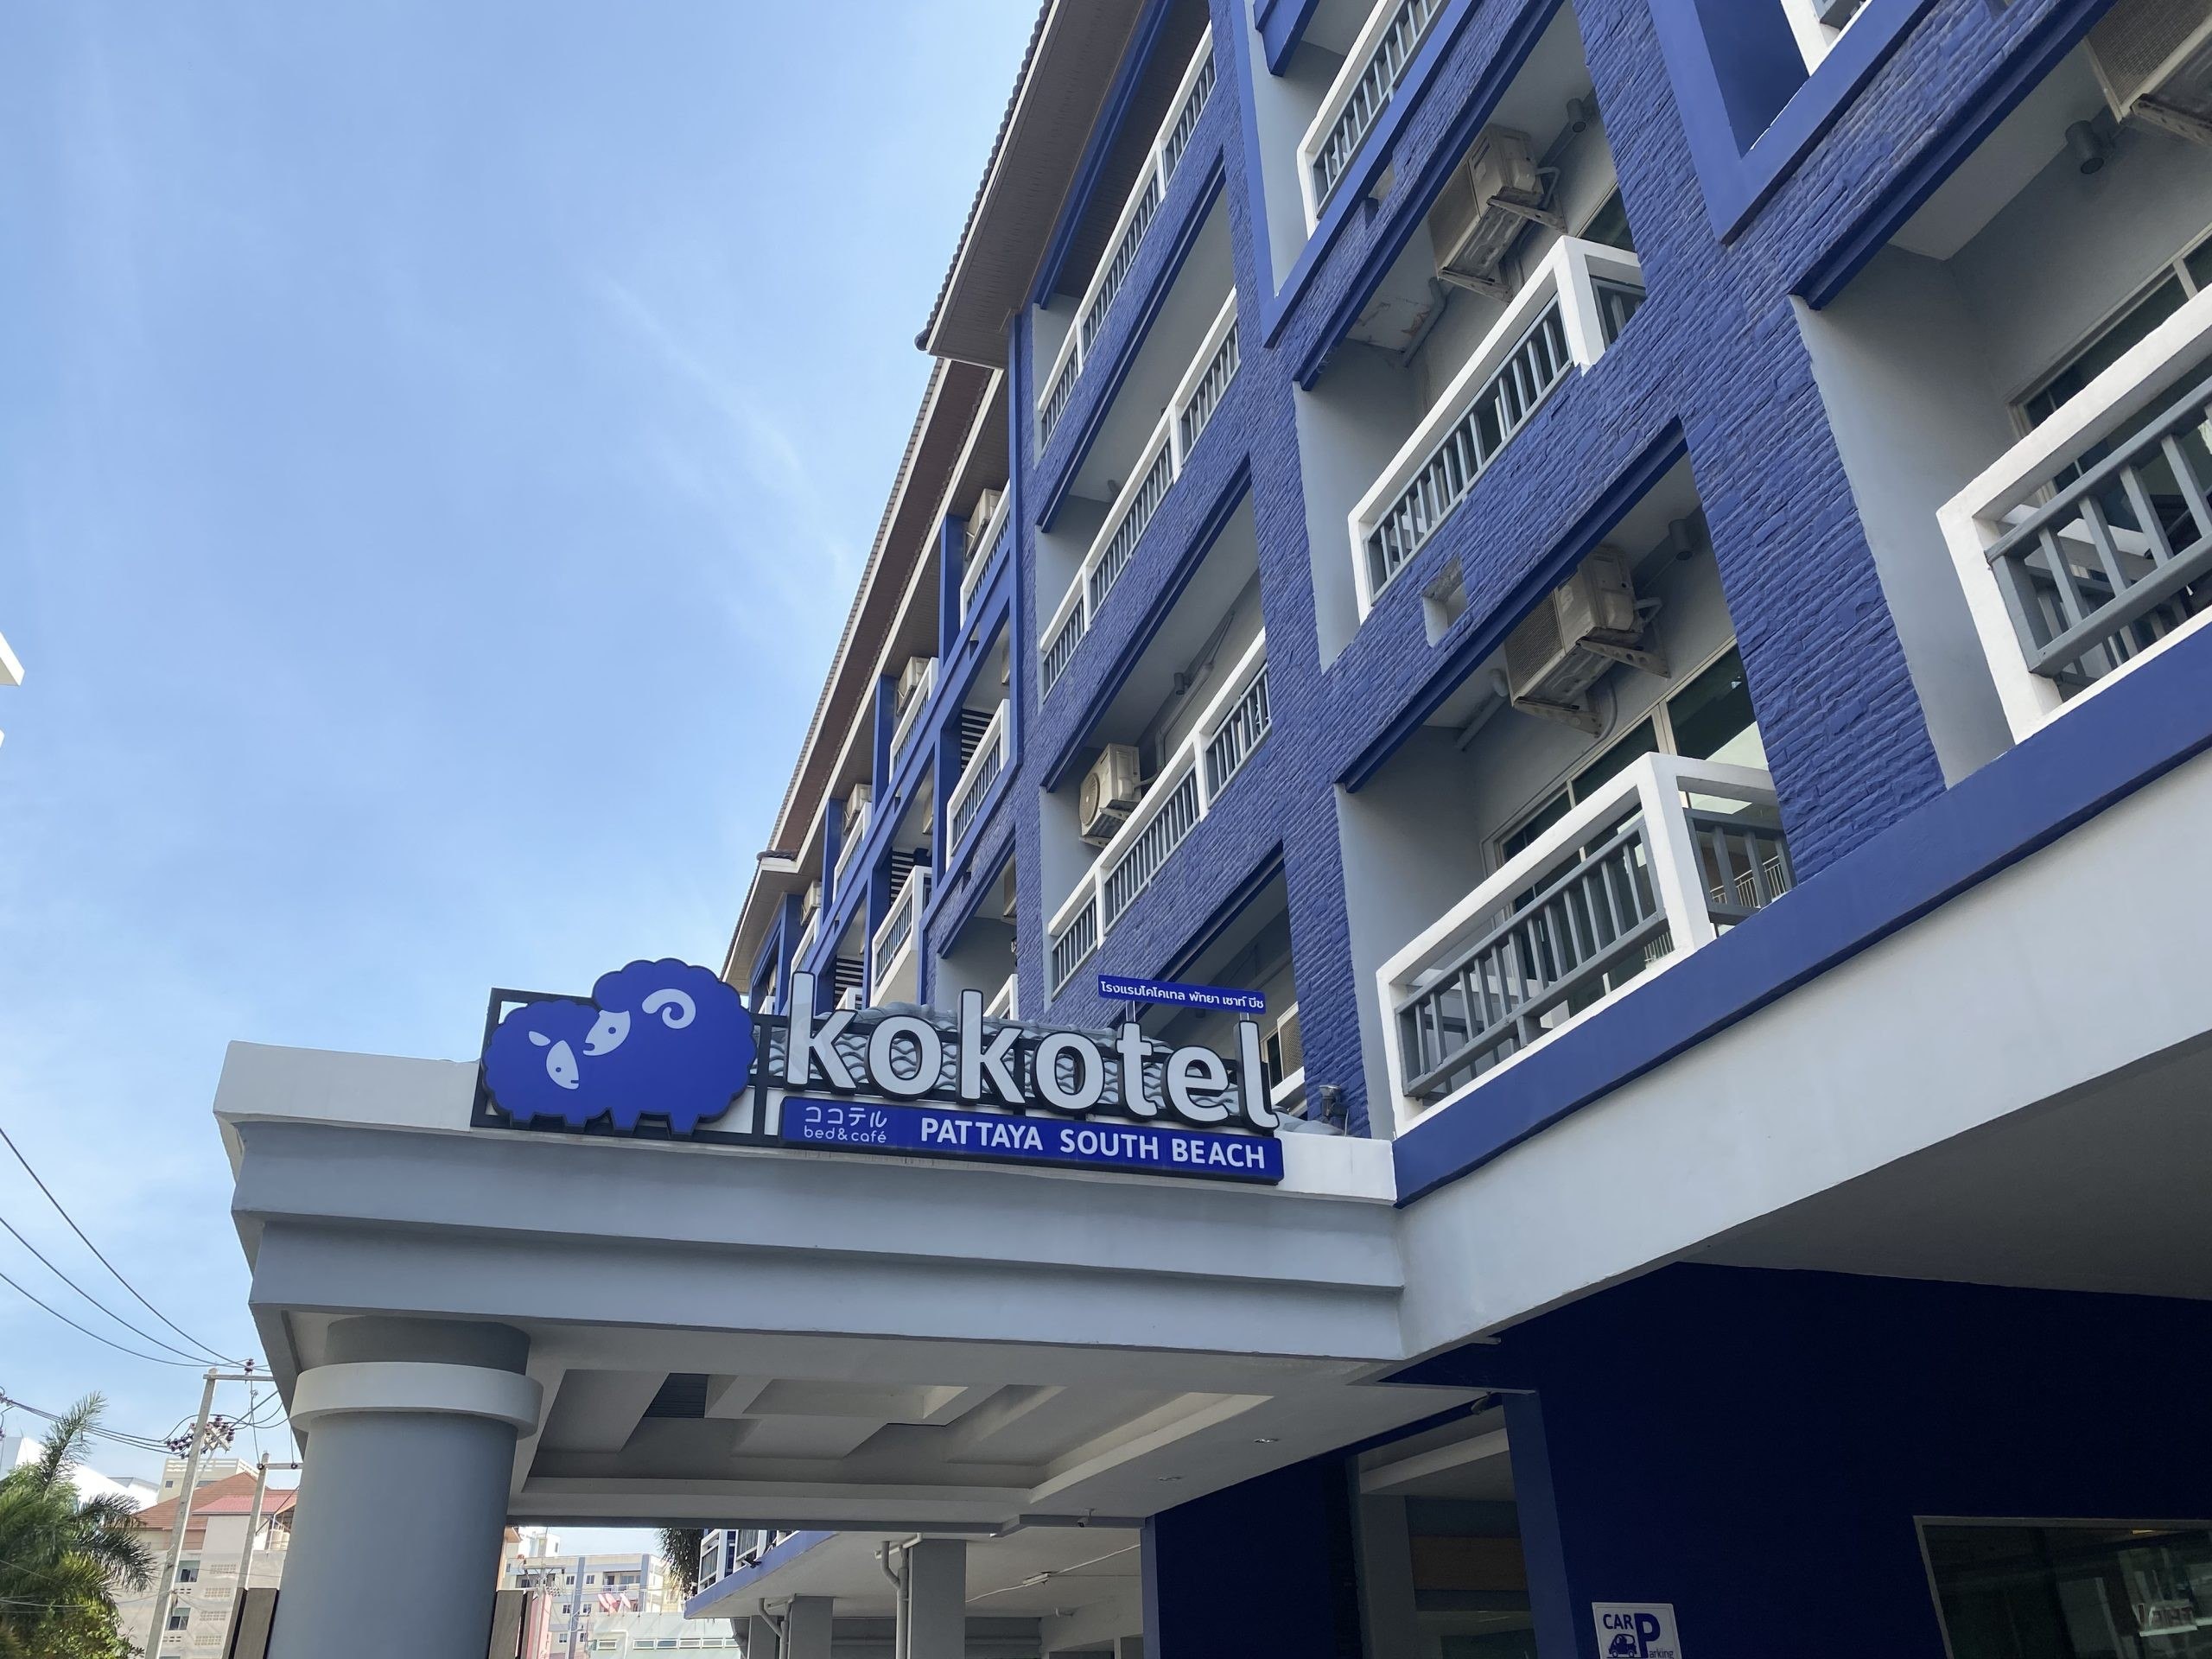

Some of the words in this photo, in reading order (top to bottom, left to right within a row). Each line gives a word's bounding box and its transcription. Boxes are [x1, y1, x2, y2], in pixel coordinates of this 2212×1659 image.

[1100, 981, 1185, 1001] โรงแรมโคโคเทล
[1188, 990, 1220, 1005] พัทยา
[1248, 996, 1265, 1009] บีช
[784, 971, 1280, 1130] kokotel
[804, 1106, 887, 1128] ココテル
[921, 1117, 1043, 1151] PATTAYA
[1059, 1128, 1159, 1160] SOUTH
[1172, 1138, 1265, 1169] BEACH
[1603, 1613, 1634, 1630] CAR
